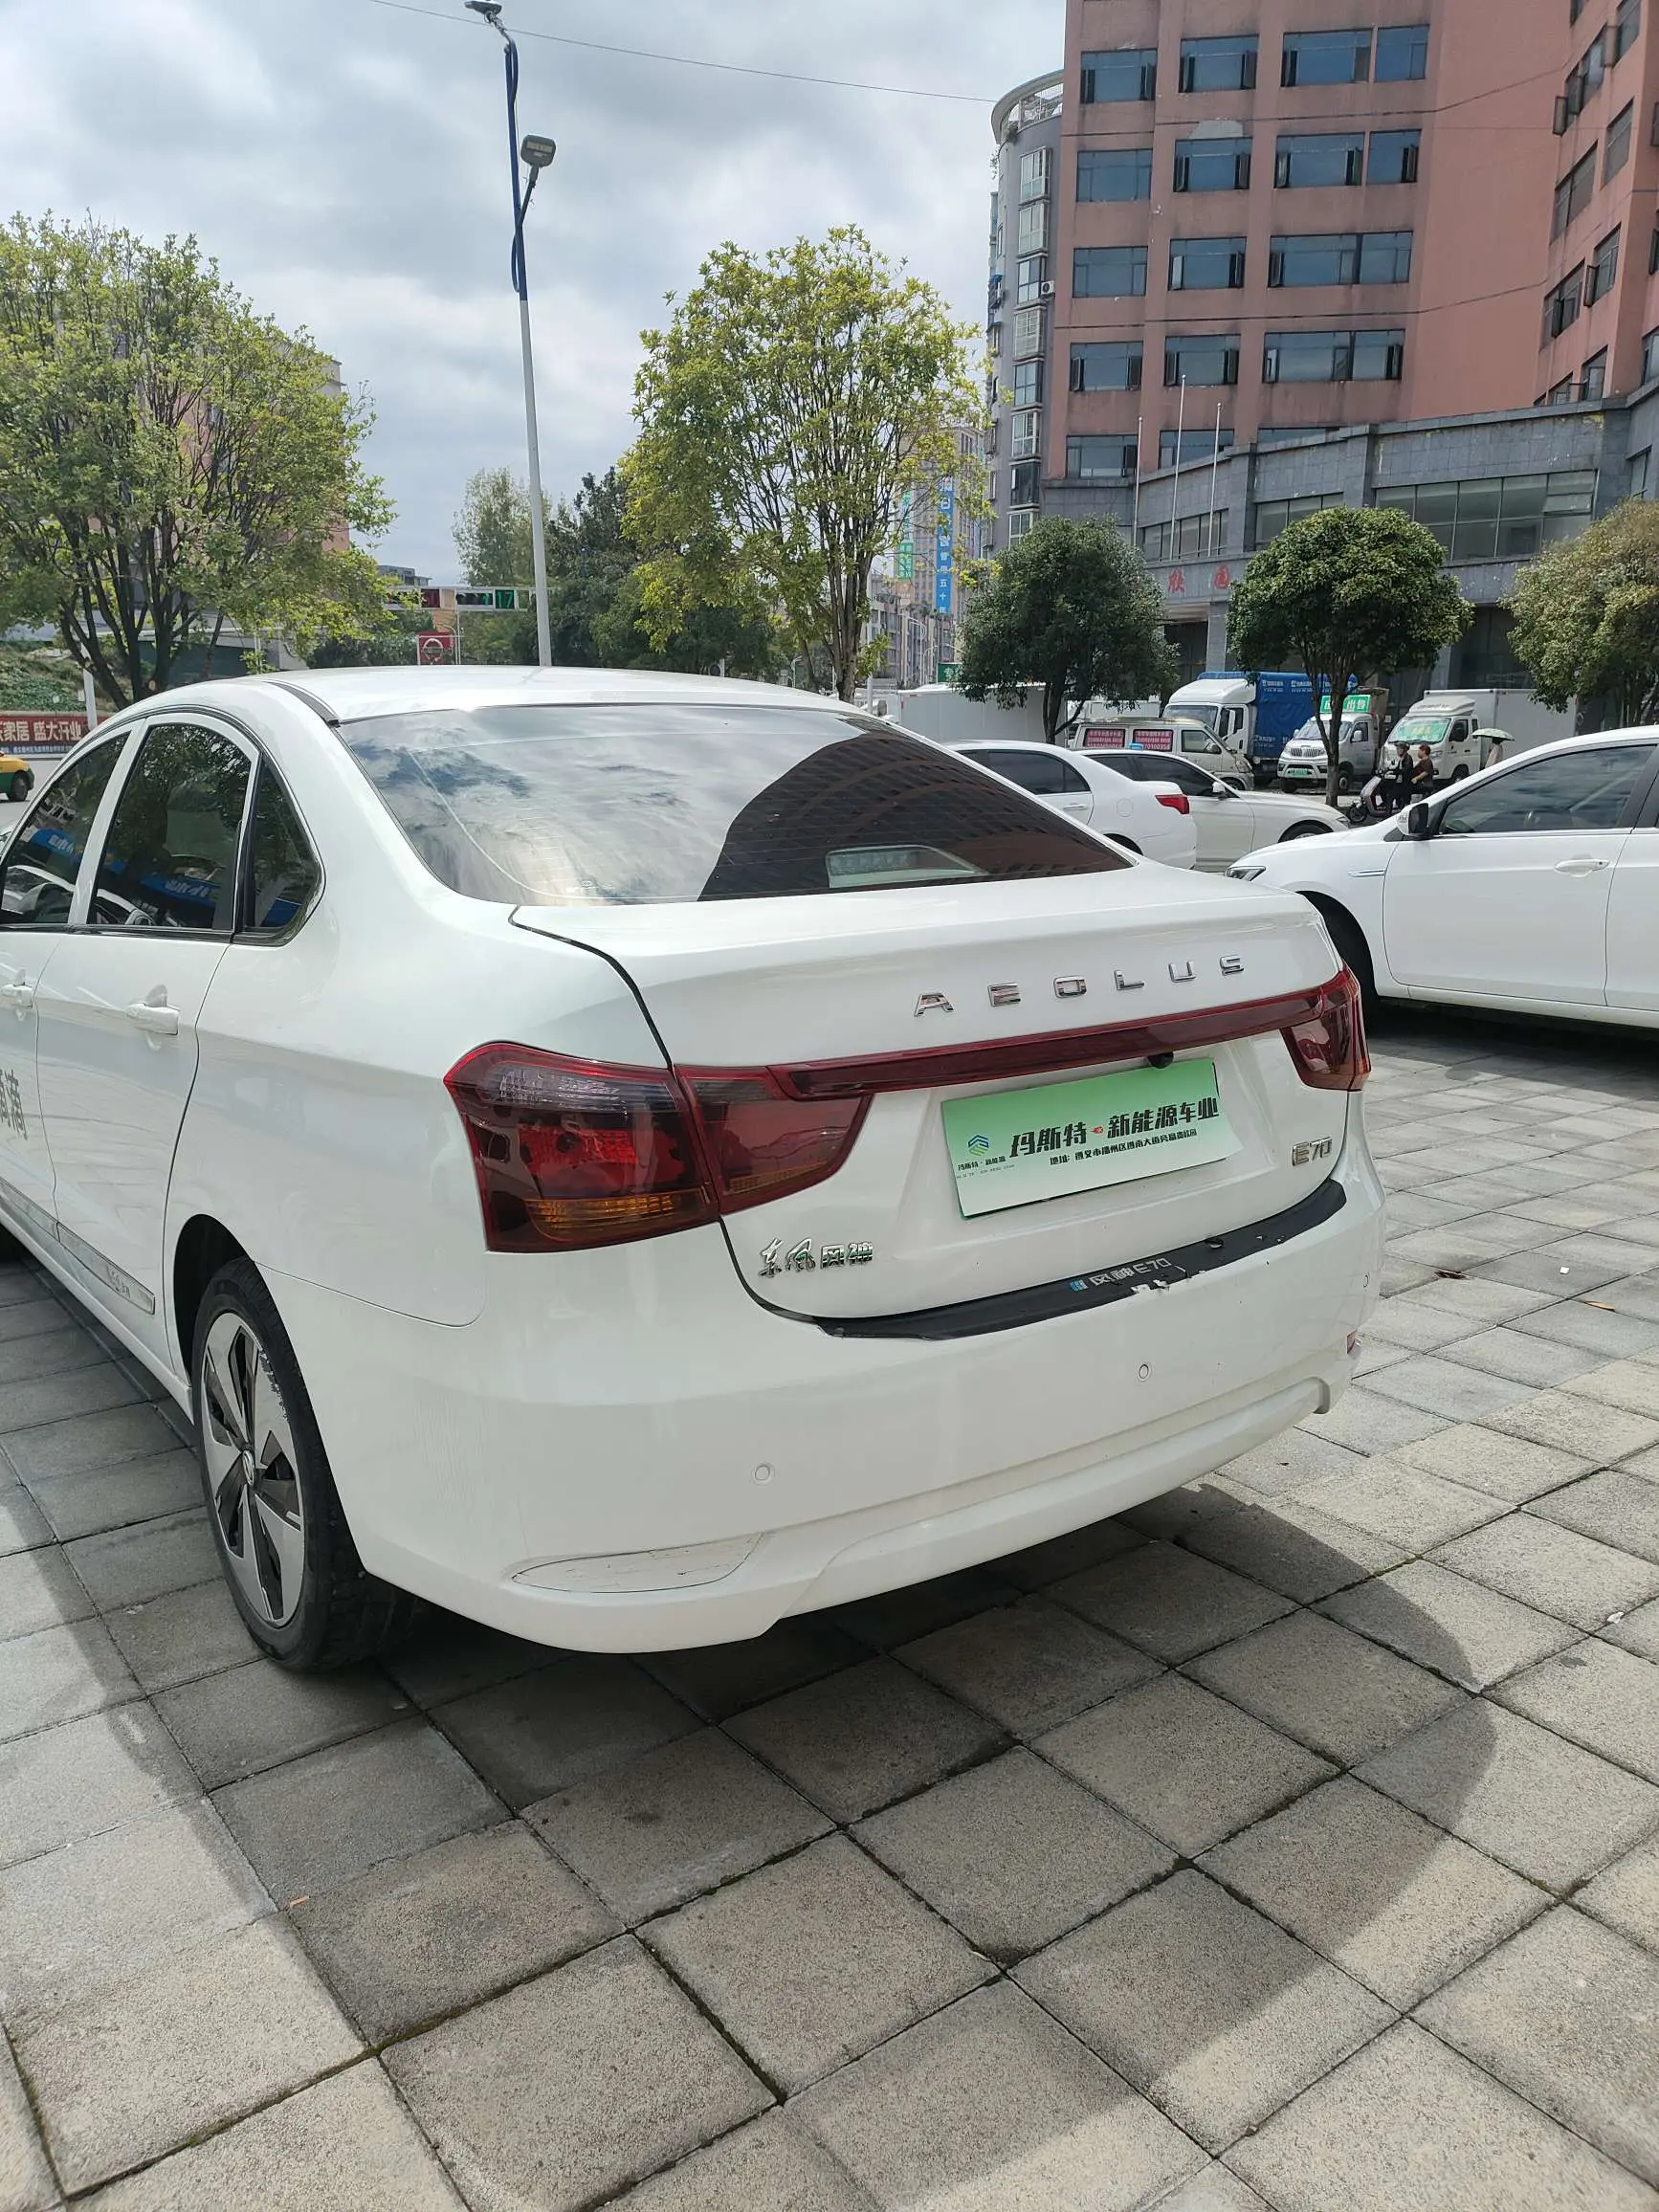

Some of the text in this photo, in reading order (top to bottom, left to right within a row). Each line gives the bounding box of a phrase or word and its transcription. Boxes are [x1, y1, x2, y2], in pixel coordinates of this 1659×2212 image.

[33, 720, 82, 741] 盛大开业
[914, 954, 1246, 1017] AEOLUS
[1009, 1096, 1220, 1158] 玛斯特 新能源车业
[1292, 1137, 1333, 1166] E70
